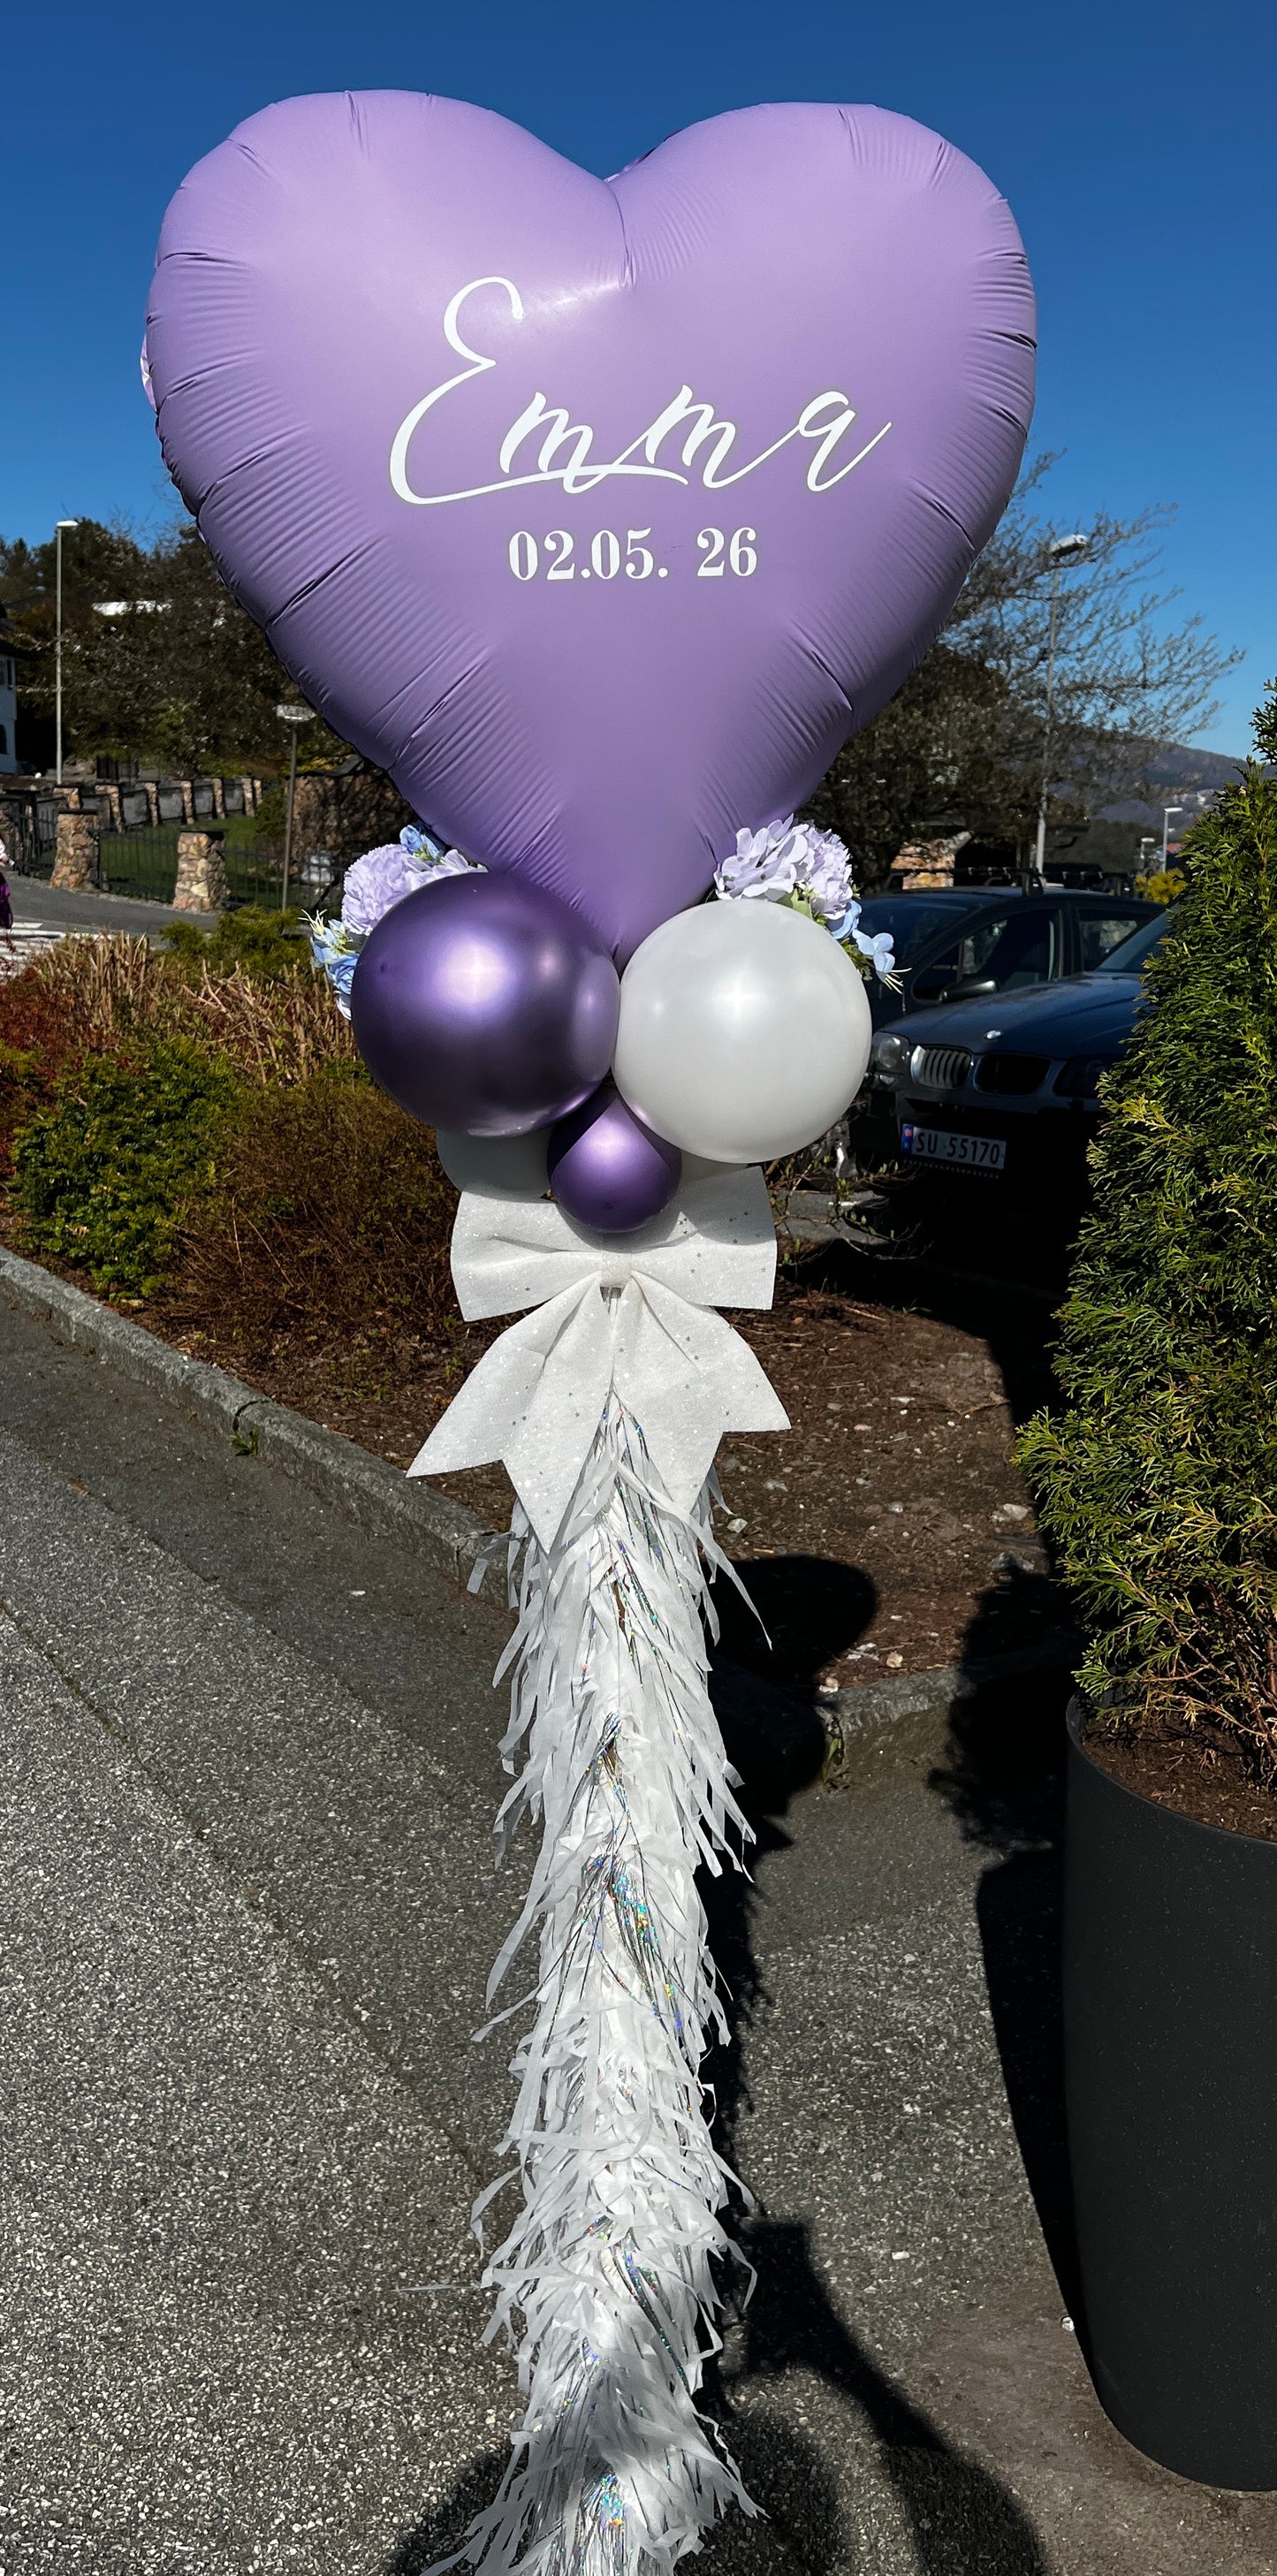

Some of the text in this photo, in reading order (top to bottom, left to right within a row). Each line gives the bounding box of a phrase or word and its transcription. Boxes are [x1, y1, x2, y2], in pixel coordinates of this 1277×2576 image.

[390, 277, 892, 505] Emma
[508, 527, 758, 581] 02.05. 26
[916, 1132, 1000, 1165] SU 55170
